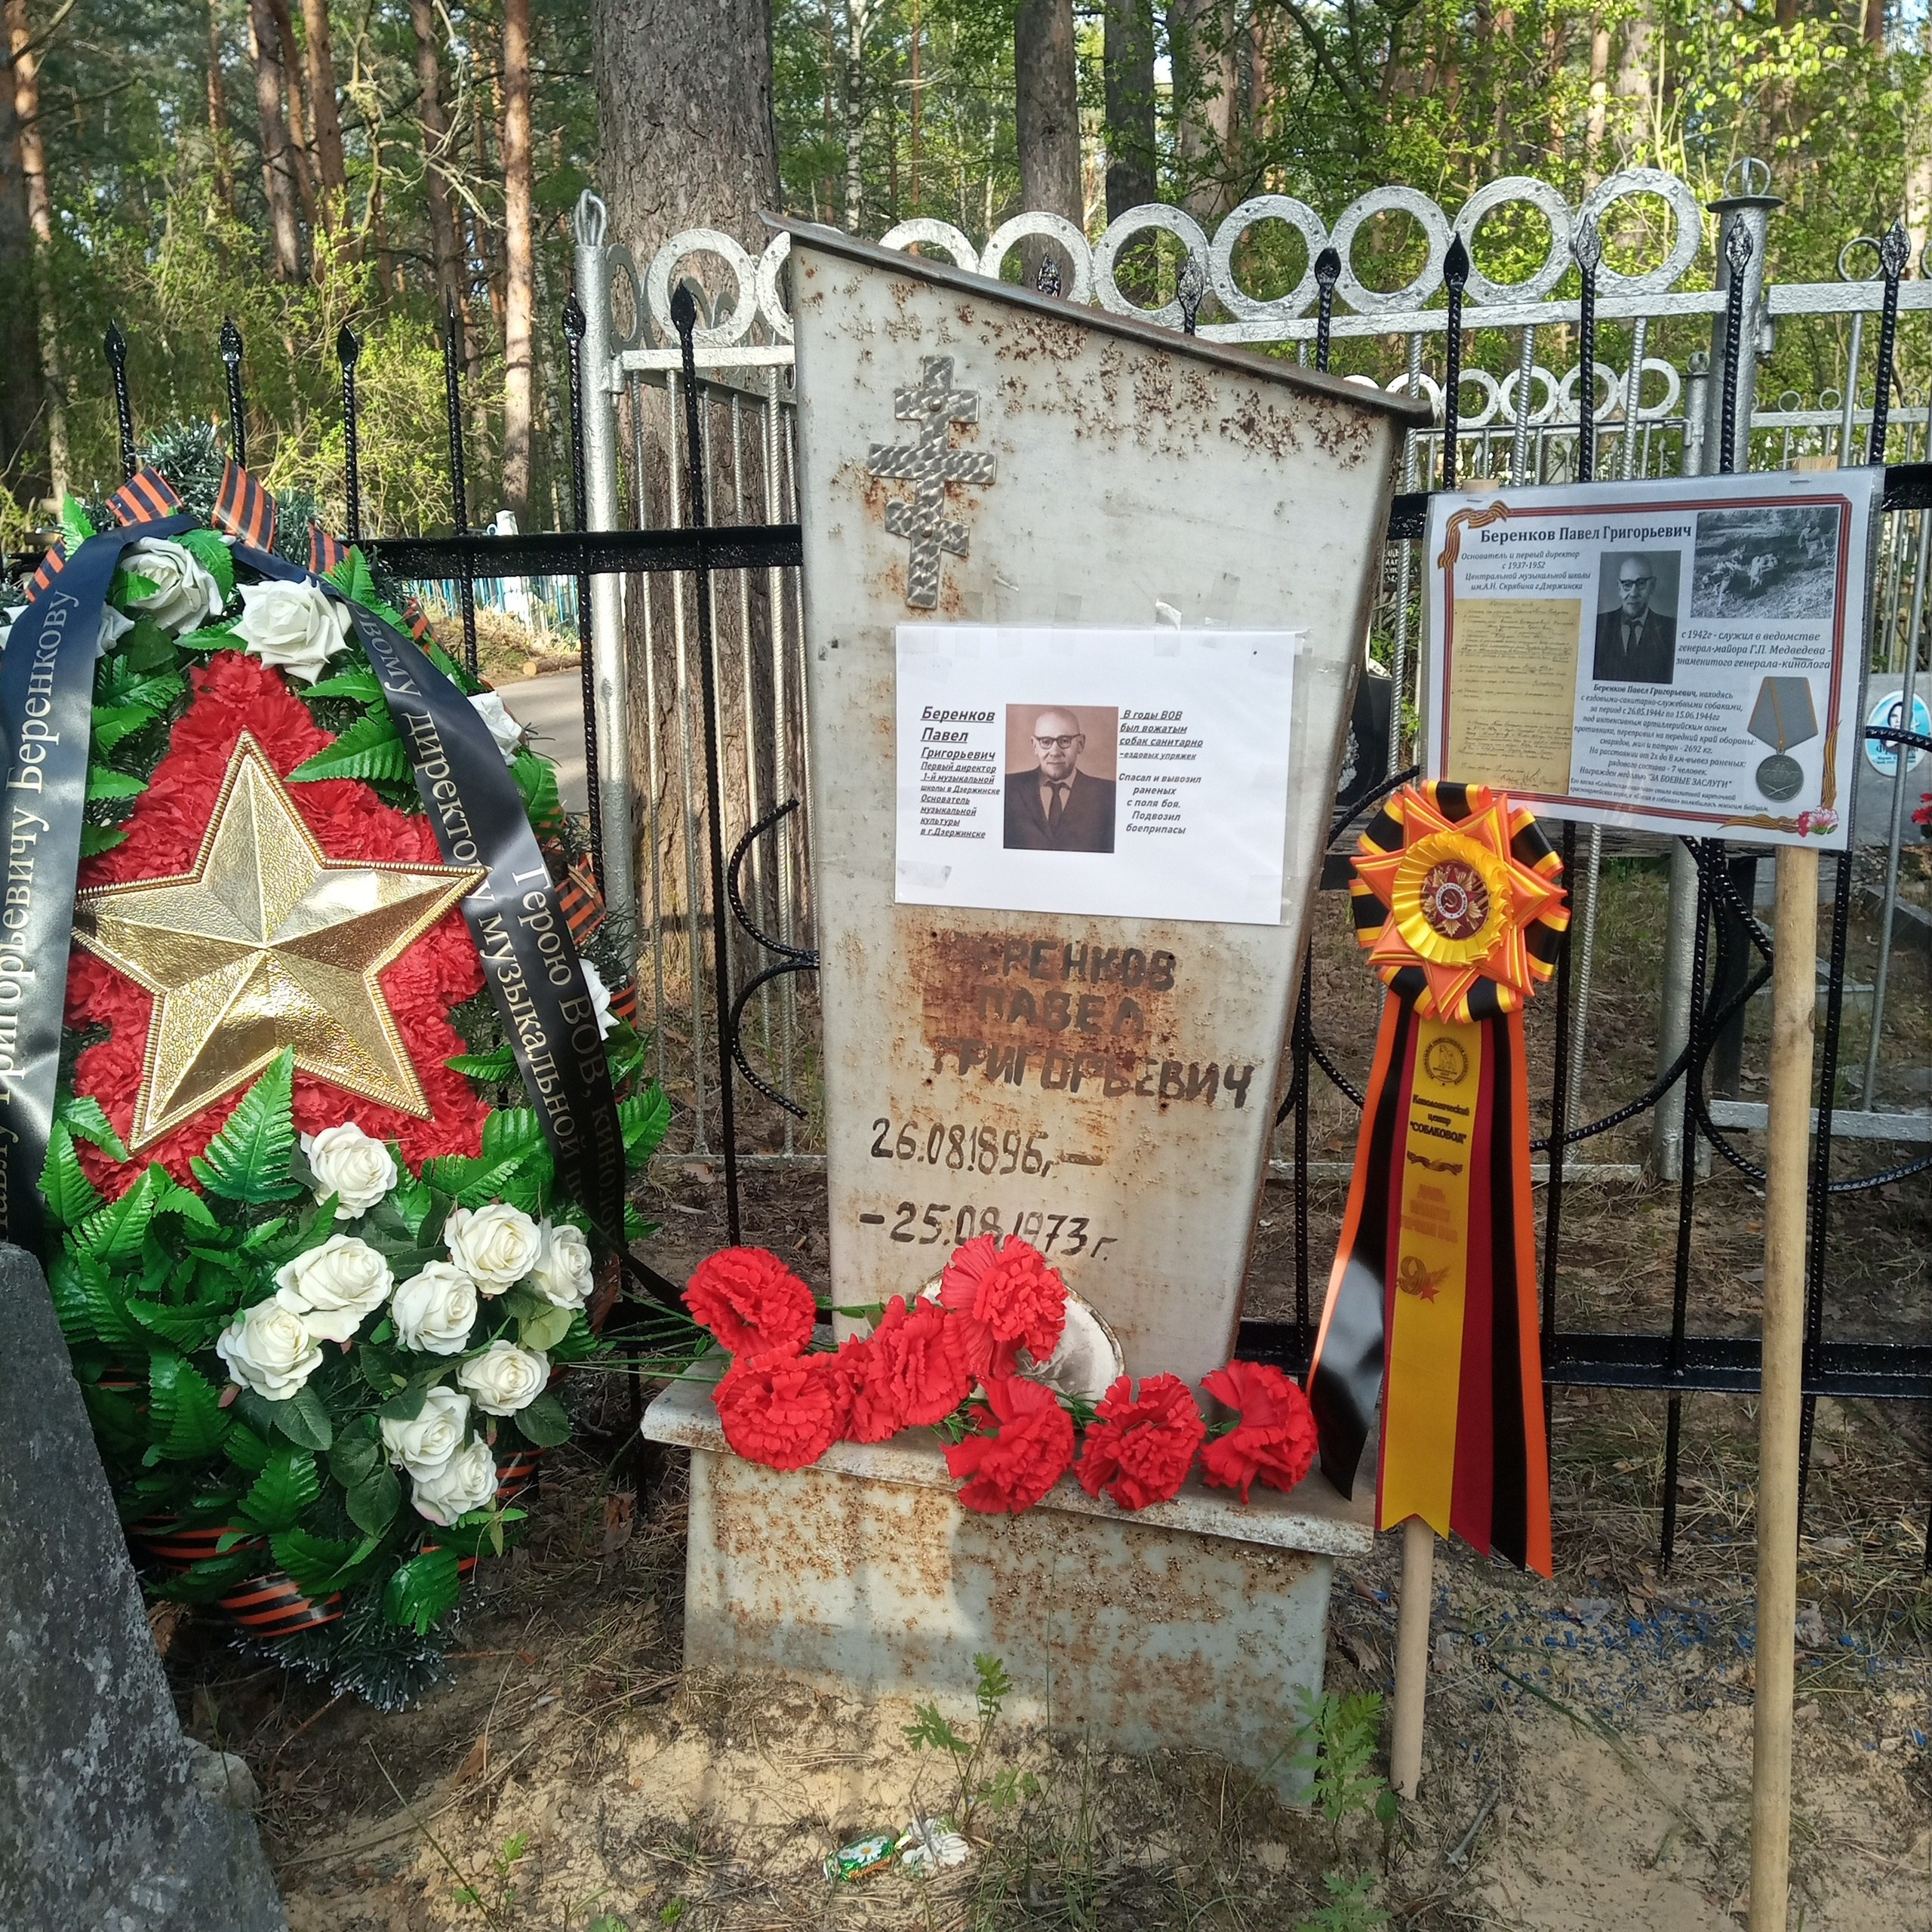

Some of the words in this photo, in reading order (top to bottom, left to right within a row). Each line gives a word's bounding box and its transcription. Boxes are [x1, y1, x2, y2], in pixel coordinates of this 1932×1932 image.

[1481, 529, 1555, 545] Беренков
[1558, 527, 1600, 540] Павел
[1602, 525, 1692, 542] Григорьевич
[1461, 552, 1508, 560] Основатель
[1515, 550, 1544, 561] первый
[1545, 550, 1580, 559] директор
[1465, 572, 1518, 581] Центральной
[1518, 571, 1567, 581] музыкальной
[1499, 582, 1534, 592] Скрябина
[1687, 630, 1713, 639] 1942г
[1718, 632, 1754, 641] служил
[1763, 631, 1821, 641] ведомстве
[1678, 644, 1748, 655] генерал-майора
[1769, 645, 1826, 655] Медведева
[1675, 657, 1733, 667] знаменитого
[1734, 659, 1831, 670] генерала-кинолога
[5, 589, 79, 795] Беренкову
[1593, 683, 1626, 694] Беренков
[1627, 685, 1649, 694] Павел
[1650, 687, 1698, 698] Григорьевич,
[1699, 690, 1734, 700] находясь
[1598, 706, 1622, 715] период
[1704, 701, 1743, 712] собаками,
[921, 706, 995, 723] Беренков
[1123, 709, 1131, 719] В
[1133, 712, 1158, 720] годы
[1160, 710, 1183, 721] ВОВ
[1120, 722, 1140, 733] был
[1142, 724, 1188, 734] вожатым
[1596, 717, 1641, 725] интенсивным
[1643, 720, 1703, 731] артиллерийским
[921, 727, 969, 742] Павел
[1665, 732, 1698, 742] передний
[1700, 734, 1718, 744] край
[1719, 736, 1757, 746] обороны:
[1119, 736, 1149, 746] собак
[1150, 739, 1204, 749] санитарно
[1652, 743, 1678, 752] патрон
[1684, 744, 1701, 753] 2692
[921, 746, 995, 761] Григорьевич
[1160, 752, 1197, 761] упряжек
[1599, 749, 1638, 758] расстоянии
[1659, 753, 1667, 761] до
[921, 761, 954, 771] Первый
[955, 764, 996, 774] директор
[1608, 758, 1638, 768] рядового
[1638, 763, 1666, 772] состава
[923, 772, 937, 782] 1-й
[938, 774, 995, 784] музыкальной
[1118, 773, 1152, 782] Спасал
[1580, 766, 1617, 777] Награжден
[1660, 774, 1690, 786] БОЕВЫЕ
[952, 785, 1001, 795] Дзержинске
[1132, 786, 1177, 795] раненых
[921, 794, 971, 804] Основатель
[1161, 798, 1181, 808] боя.
[921, 806, 977, 816] музыкальной
[1131, 811, 1182, 821] Подвозил
[920, 817, 961, 827] культуры
[1126, 823, 1186, 835] боеприпасы
[401, 710, 496, 903] директоу
[478, 912, 588, 1160] музыкальной
[0, 805, 50, 1106] ригорьевичу
[512, 863, 572, 986] Герою
[558, 995, 605, 1097] ВОВ,
[979, 984, 1145, 1038] ПАВЕЛ
